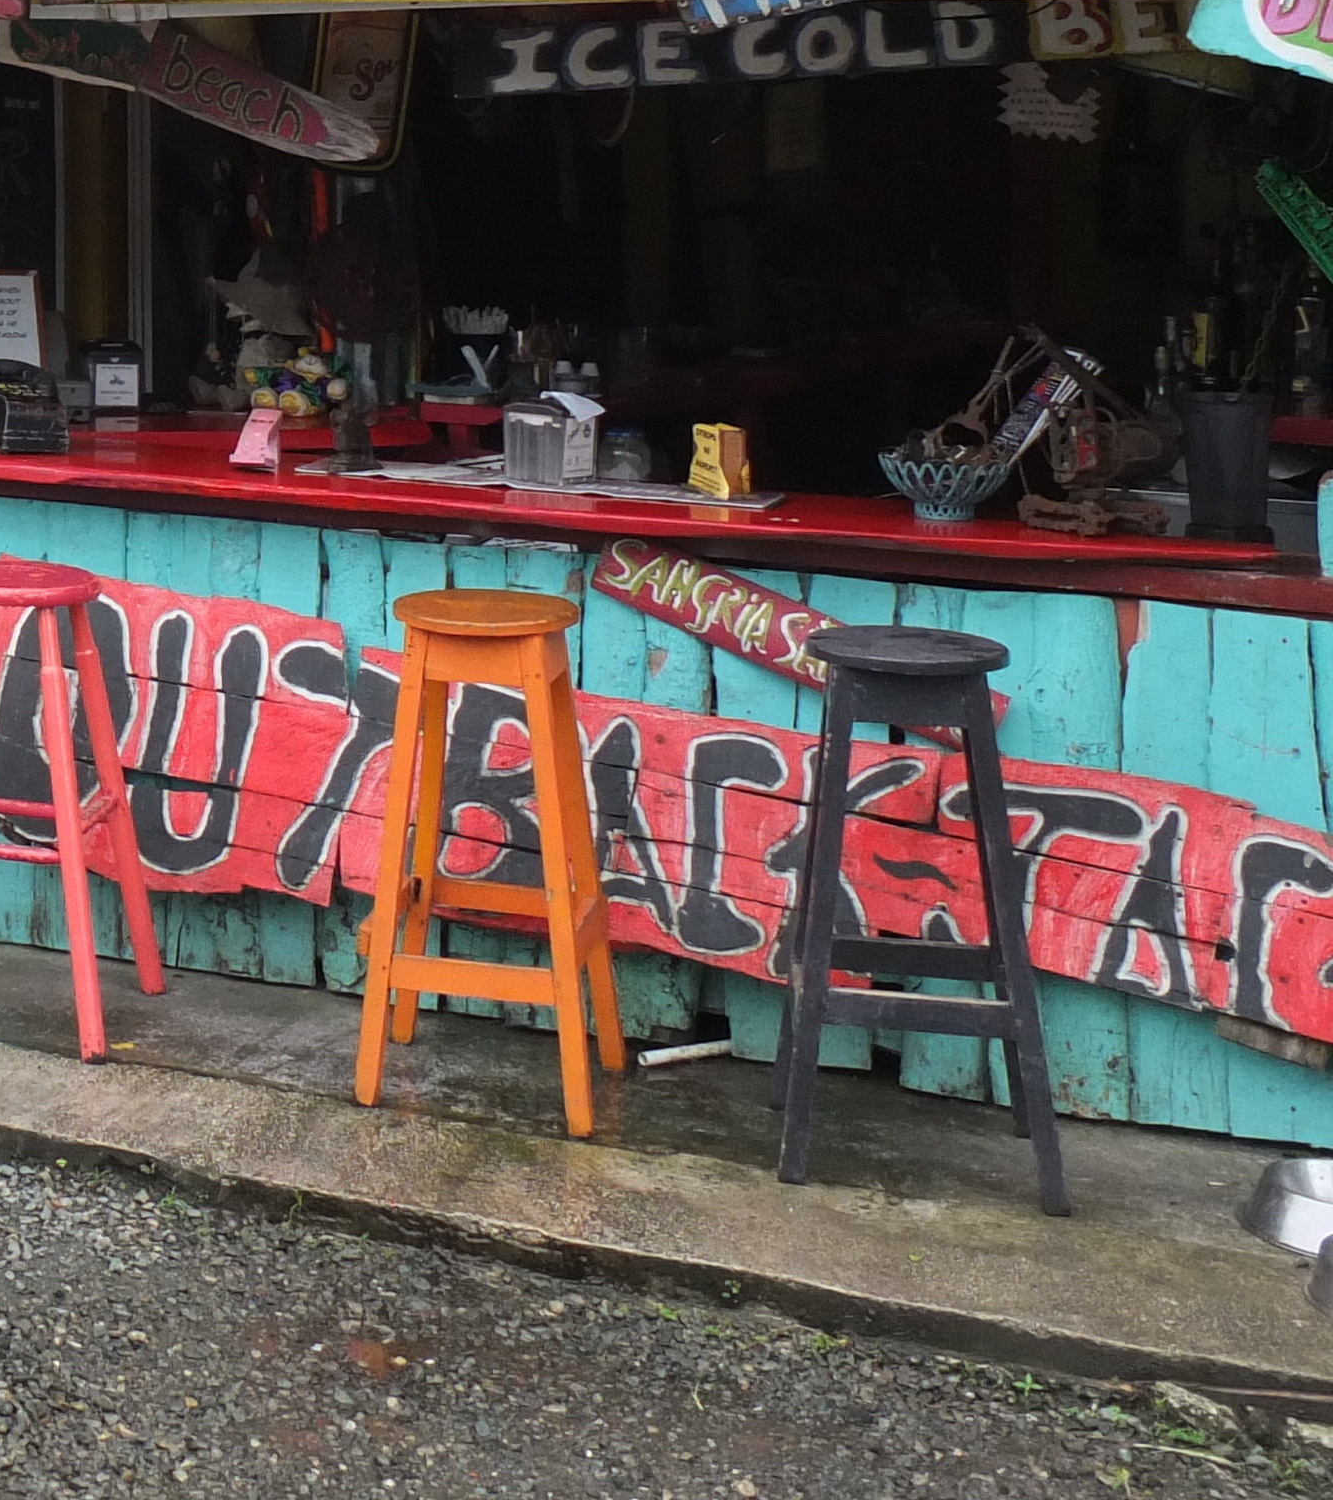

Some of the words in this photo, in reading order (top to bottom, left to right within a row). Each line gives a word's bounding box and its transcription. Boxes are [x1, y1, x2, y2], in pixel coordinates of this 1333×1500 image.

[162, 33, 305, 144] beach
[489, 17, 702, 94] ICE
[731, 0, 998, 80] COLD
[604, 538, 777, 656] SANGRIA
